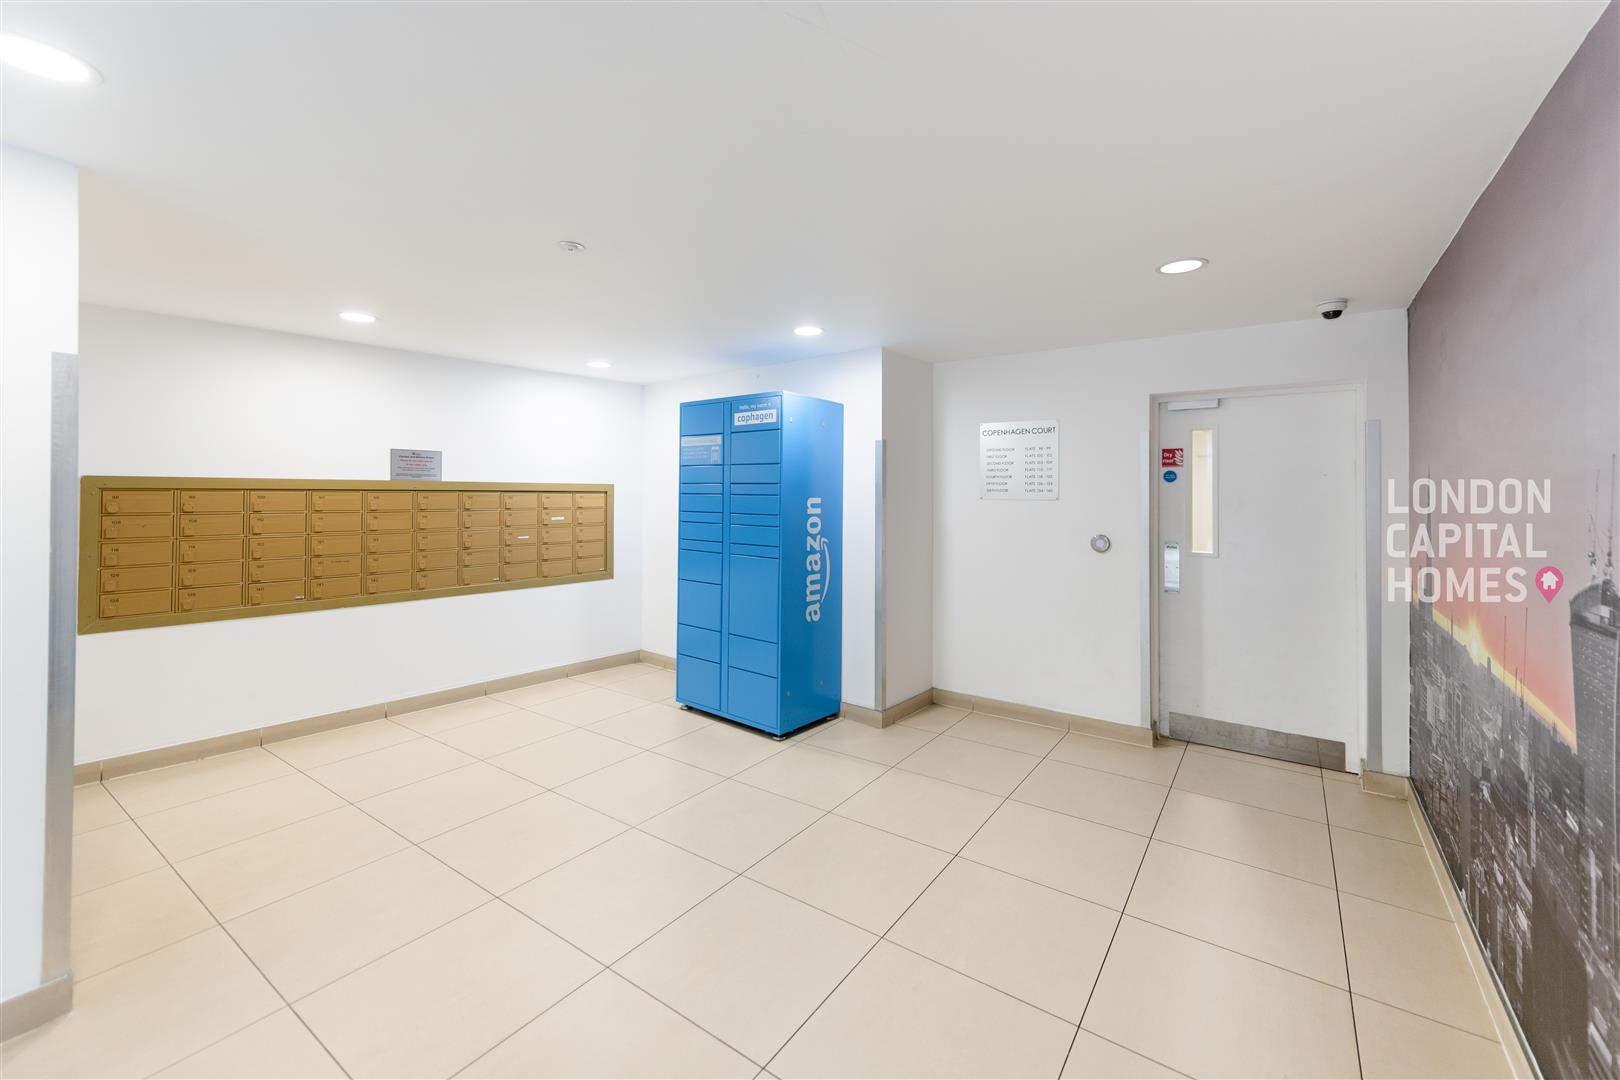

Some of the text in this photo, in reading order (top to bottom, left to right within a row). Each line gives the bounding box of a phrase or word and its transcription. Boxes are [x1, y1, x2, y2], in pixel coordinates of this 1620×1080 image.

[738, 412, 774, 423] cophagen
[982, 426, 1056, 436] COPENHAGEN COURT
[806, 496, 822, 622] amazon
